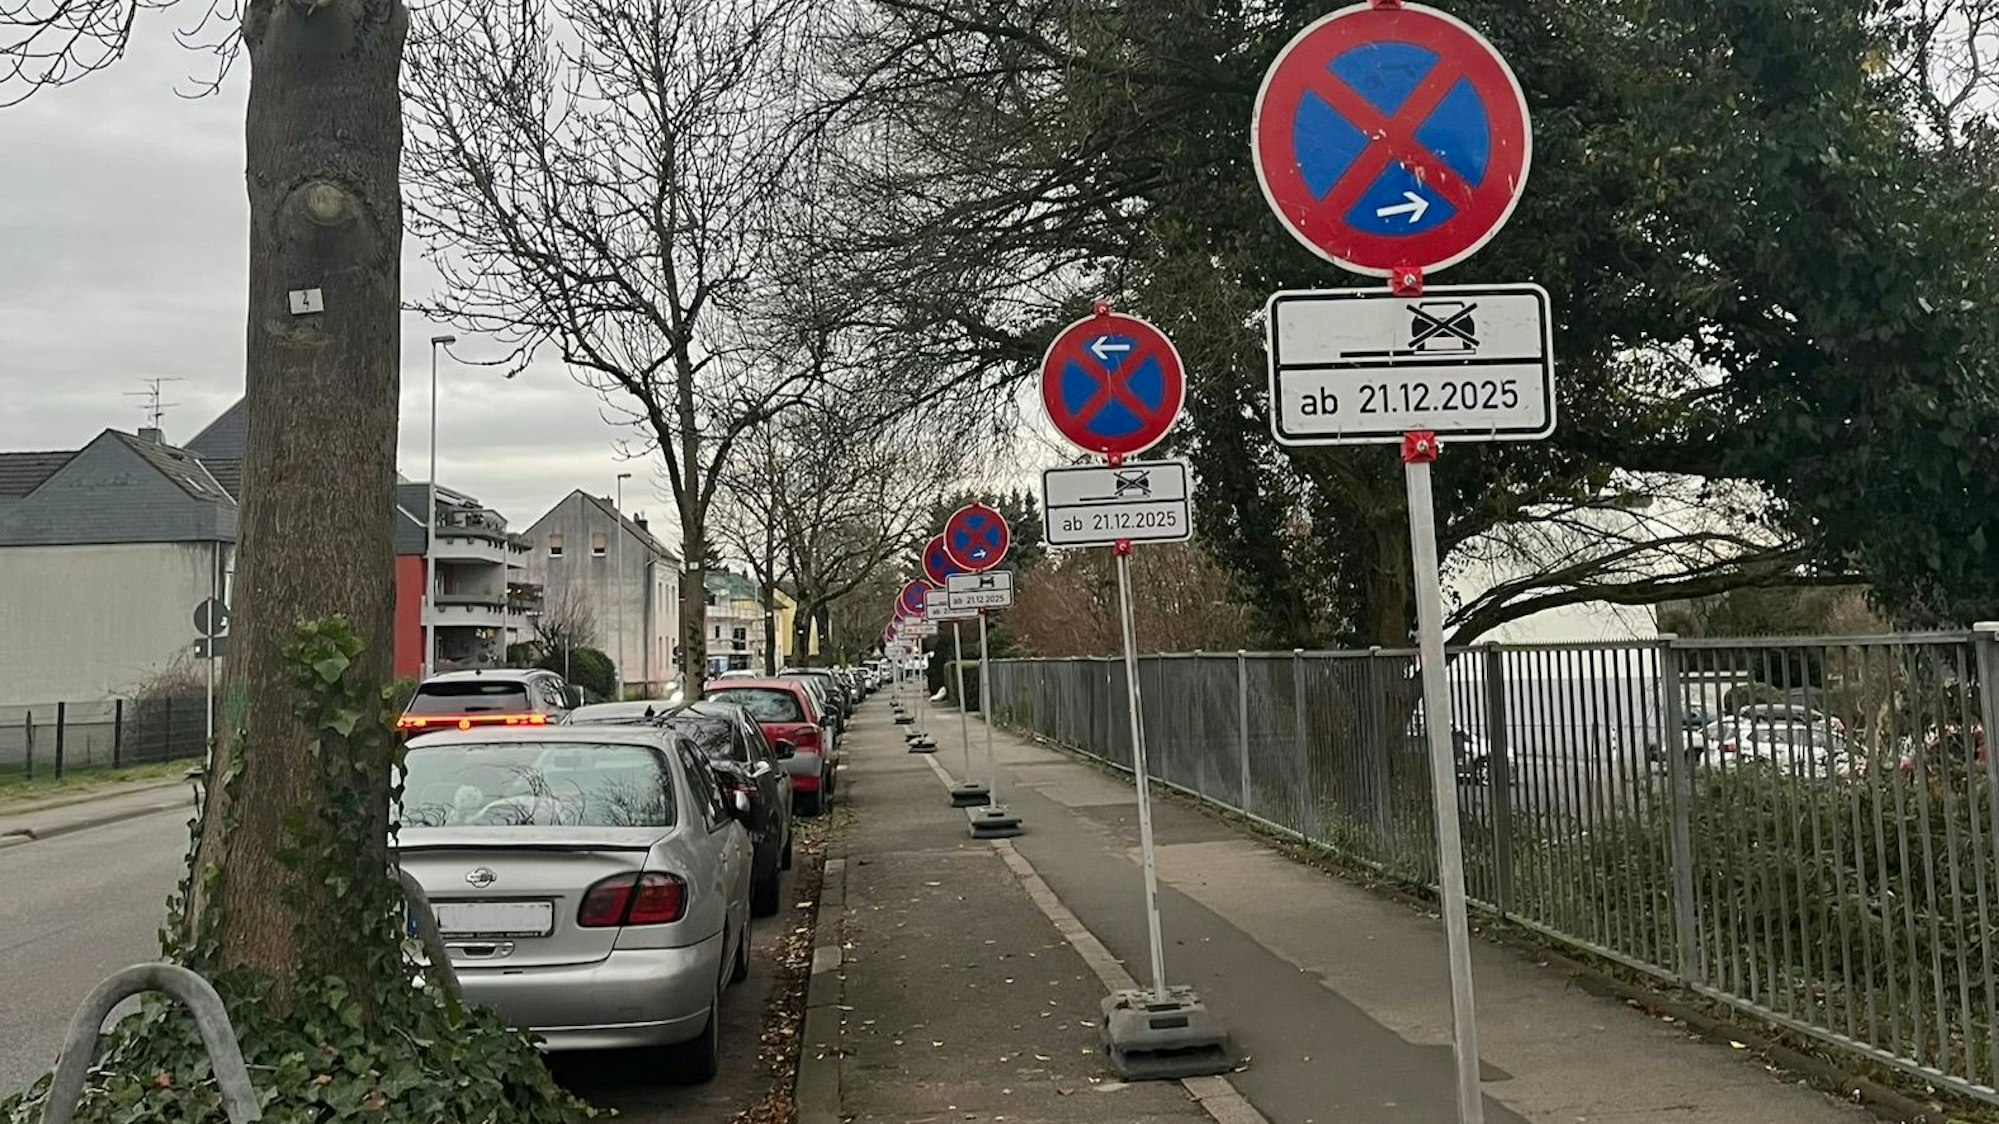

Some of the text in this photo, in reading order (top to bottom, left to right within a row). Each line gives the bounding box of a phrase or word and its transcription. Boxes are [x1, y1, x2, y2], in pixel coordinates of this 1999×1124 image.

[1300, 380, 1518, 416] ab 21.12.2025
[1063, 511, 1176, 531] ab 21.12.2025
[966, 594, 1005, 604] 21122025
